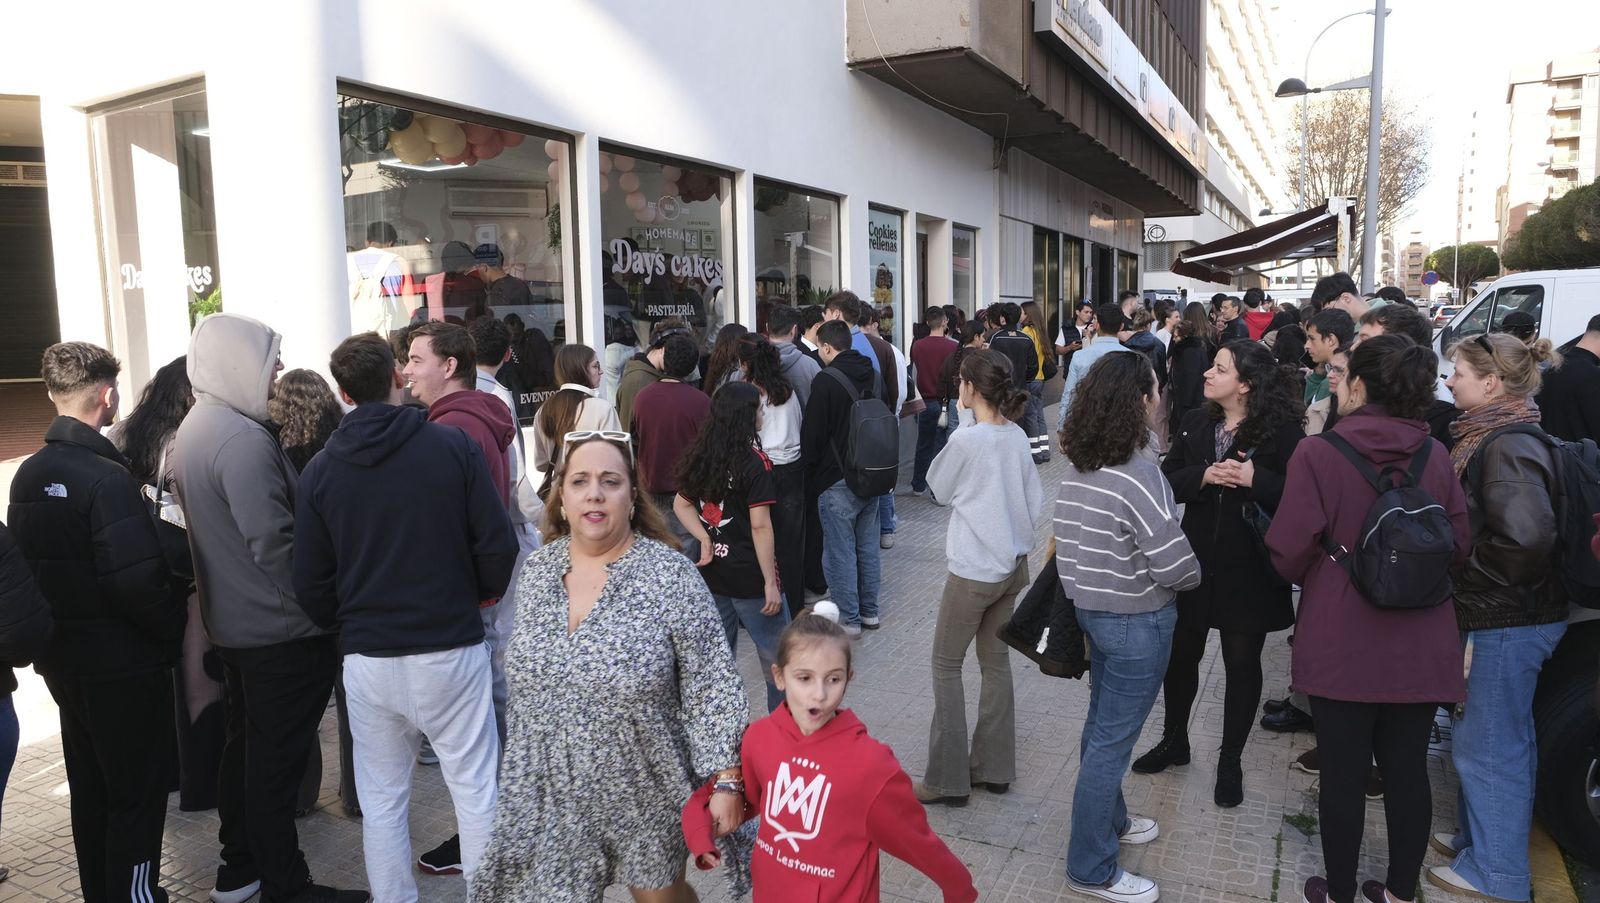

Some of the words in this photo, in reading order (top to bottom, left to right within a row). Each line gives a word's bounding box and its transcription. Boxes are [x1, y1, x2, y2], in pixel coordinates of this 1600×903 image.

[645, 228, 697, 246] HOMEMADE
[869, 221, 897, 240] Cookies
[869, 236, 897, 253] rellenas
[610, 238, 666, 285] Day's
[671, 254, 723, 286] cakes
[187, 265, 212, 293] kes
[648, 302, 696, 316] PASTELERÍA
[520, 390, 560, 404] EVENTO
[713, 542, 729, 558] 25
[756, 835, 774, 856] upos
[776, 849, 835, 878] Lestonnac
